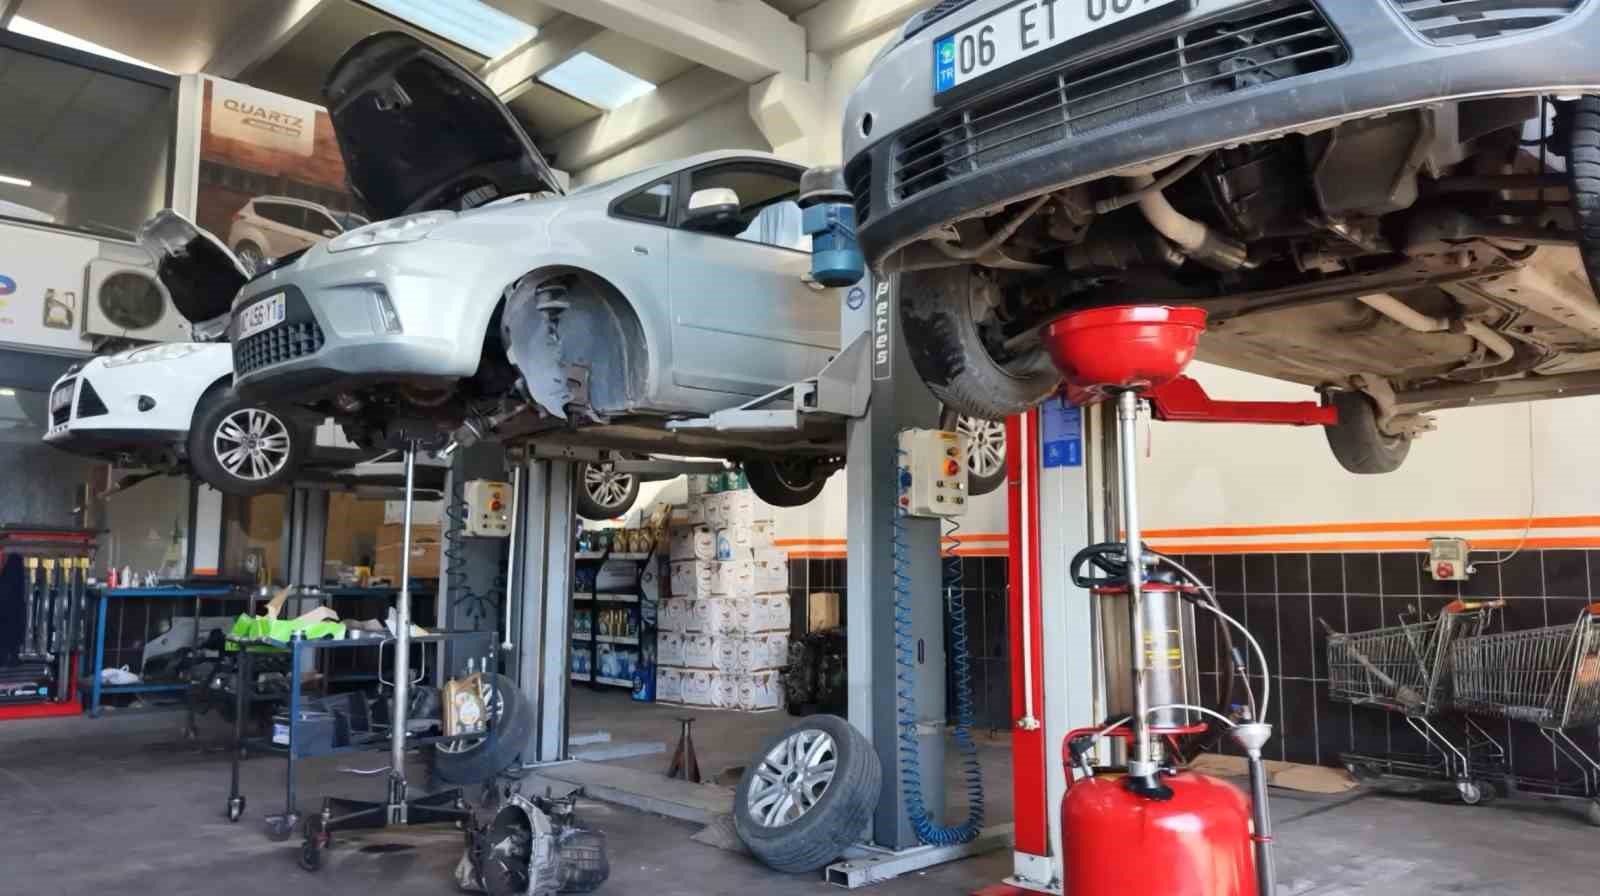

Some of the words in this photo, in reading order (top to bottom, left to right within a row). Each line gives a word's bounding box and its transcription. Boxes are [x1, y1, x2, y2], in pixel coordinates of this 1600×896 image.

[960, 25, 995, 74] 06
[1020, 0, 1057, 50] ET
[940, 67, 954, 82] TR
[223, 98, 304, 128] QUARTZ
